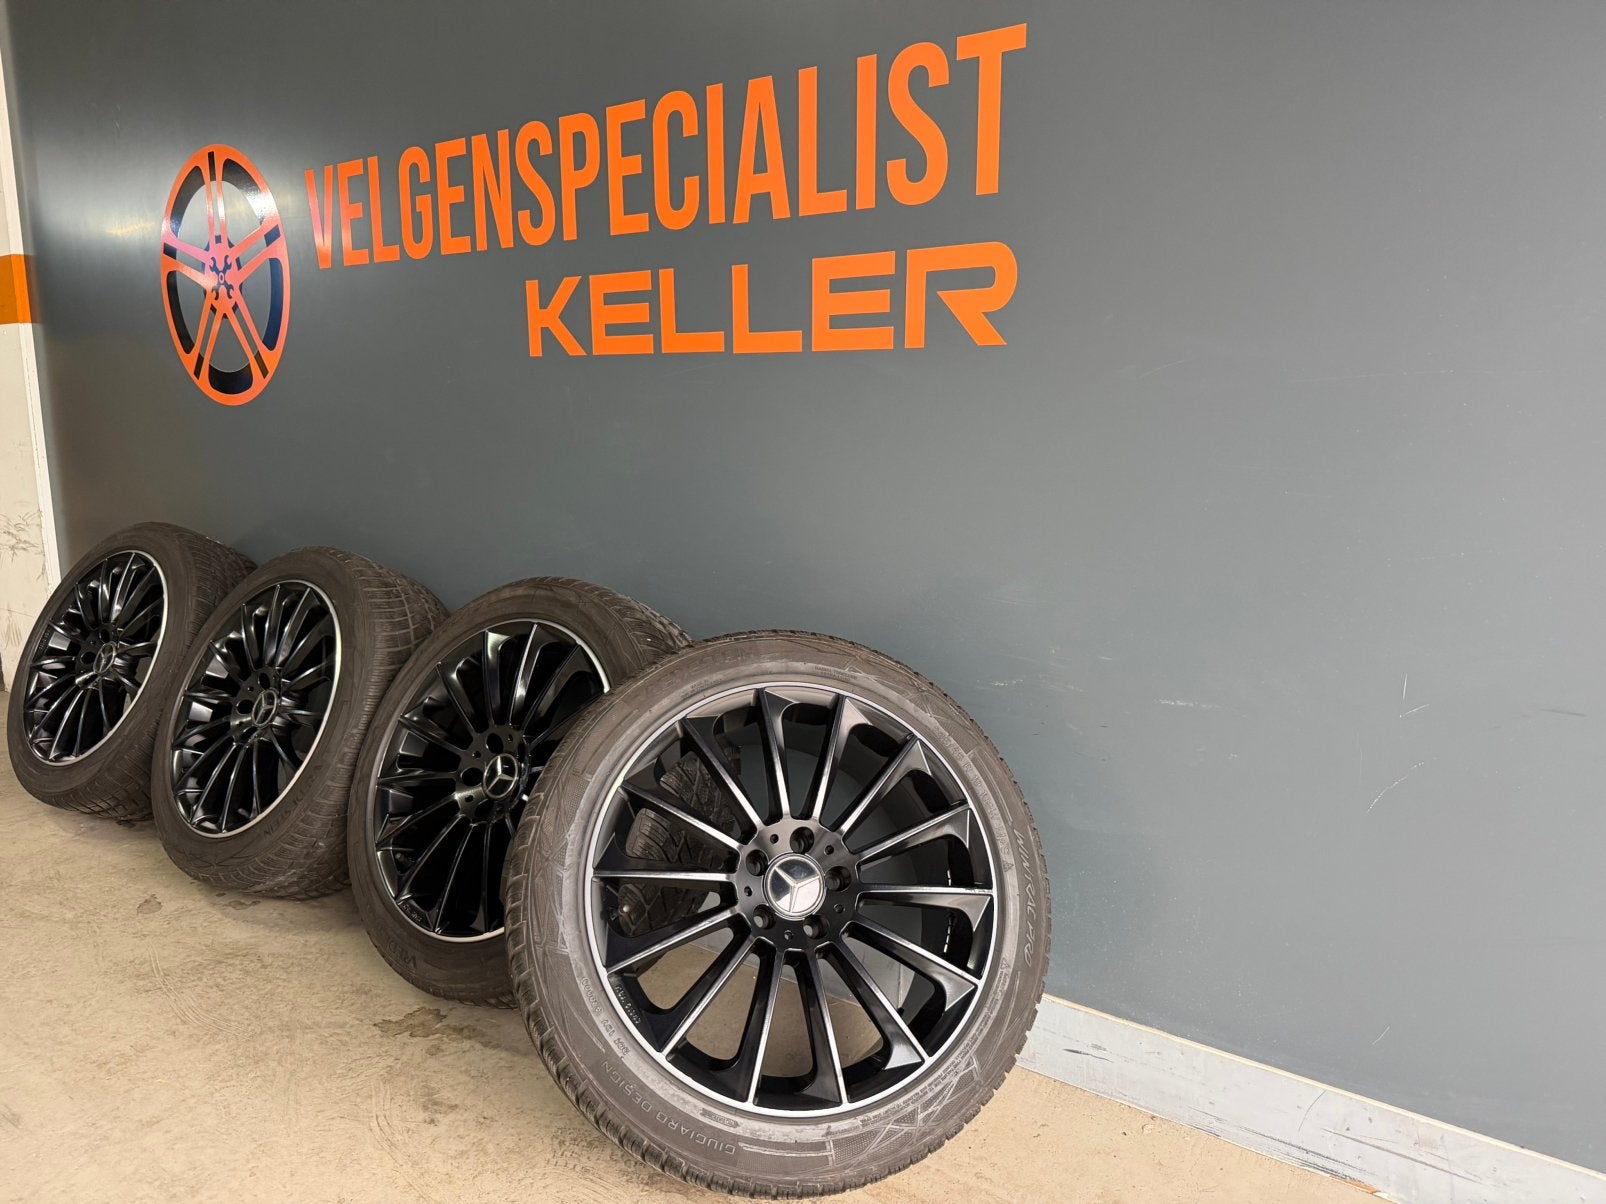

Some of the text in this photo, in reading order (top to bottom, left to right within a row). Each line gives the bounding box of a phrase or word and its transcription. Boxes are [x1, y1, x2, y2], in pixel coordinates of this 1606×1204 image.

[305, 23, 1028, 270] VELGENSPECIALIST
[525, 240, 1019, 358] KELLER
[1013, 828, 1037, 968] WINTRAC PRO
[601, 1060, 652, 1113] DESIGN
[655, 1110, 736, 1155] GIUGIARO
